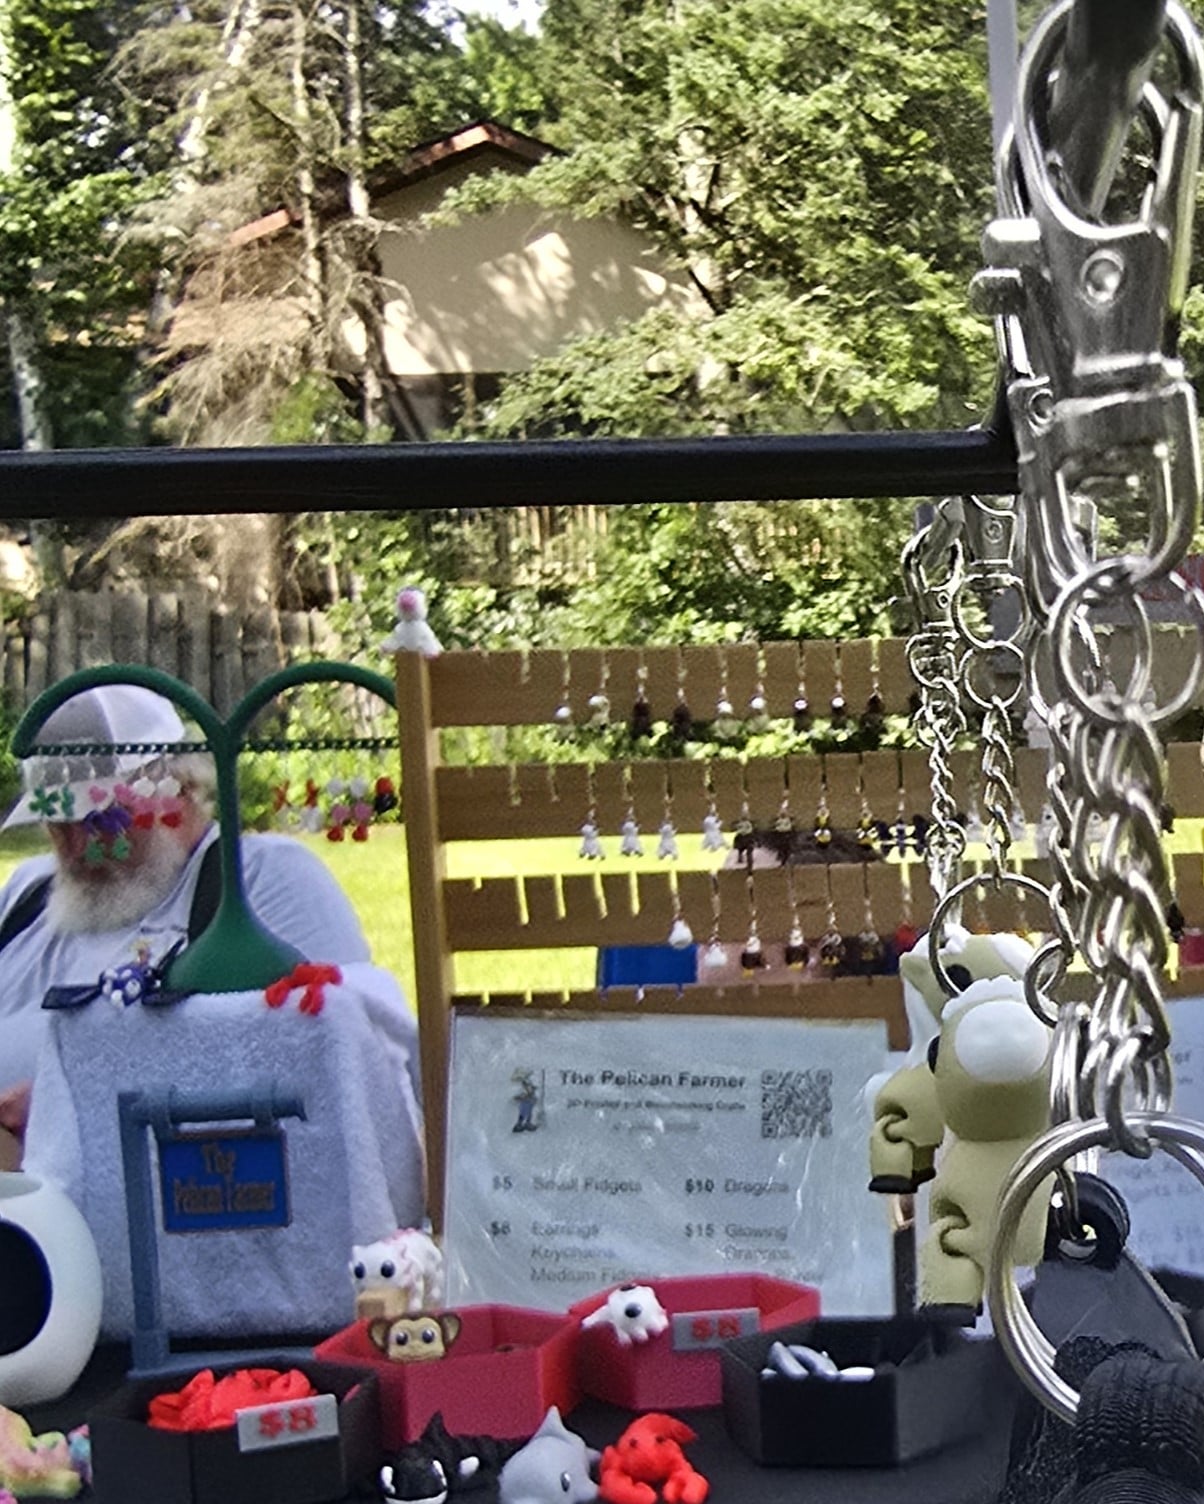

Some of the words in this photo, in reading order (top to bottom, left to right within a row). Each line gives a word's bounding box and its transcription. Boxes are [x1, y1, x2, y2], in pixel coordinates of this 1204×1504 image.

[560, 1069, 594, 1086] The
[601, 1069, 673, 1087] Pelican
[678, 1071, 747, 1089] Farmer
[685, 1178, 715, 1194] $10
